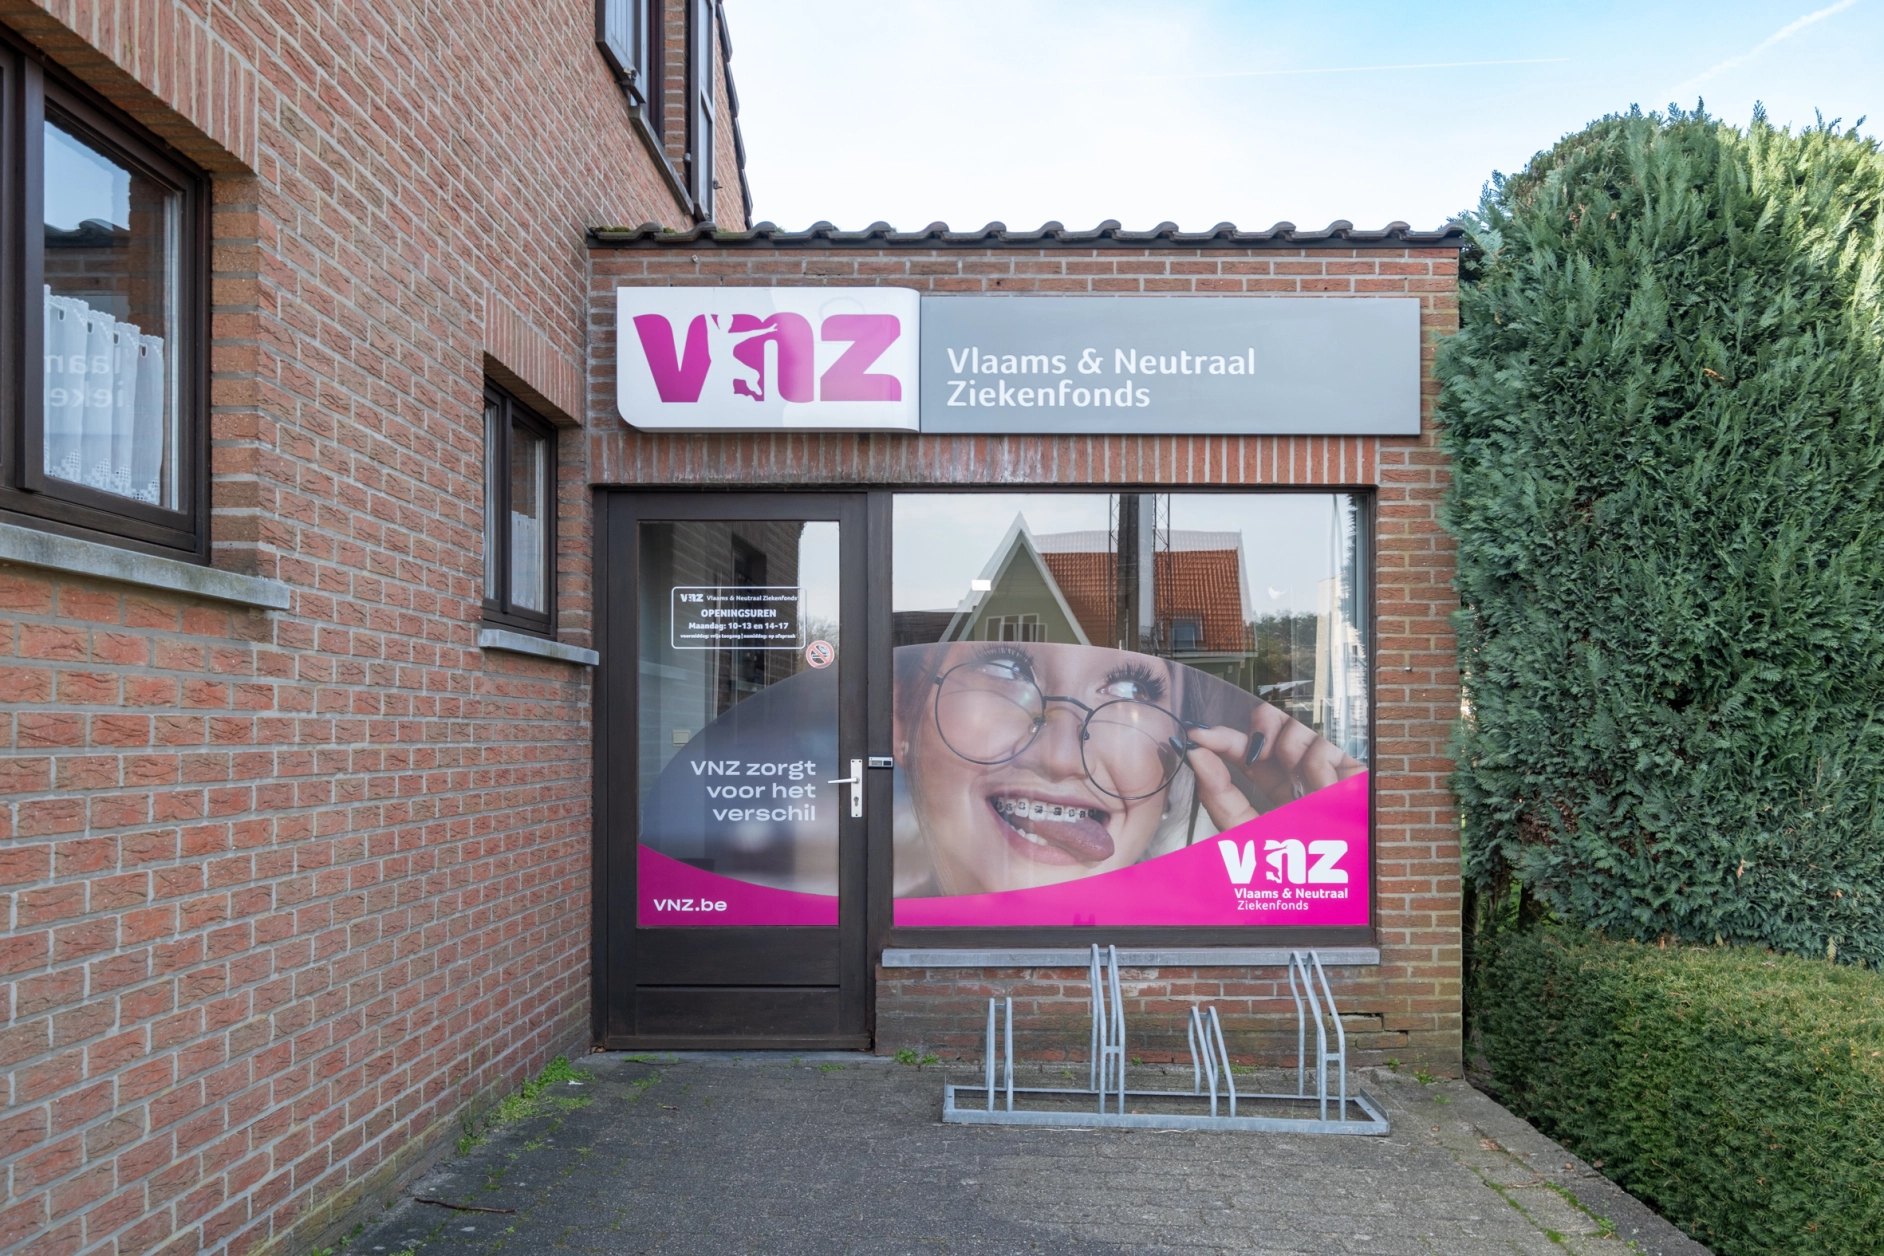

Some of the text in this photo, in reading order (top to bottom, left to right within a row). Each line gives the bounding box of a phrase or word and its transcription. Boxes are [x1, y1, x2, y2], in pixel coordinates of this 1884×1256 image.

[947, 346, 1255, 375] Vlaams & Neutraal
[946, 379, 1151, 407] Ziekenfonds
[701, 609, 777, 618] OPENINGSUREN
[688, 622, 727, 631] Maandag:
[728, 622, 752, 630] 10-13
[765, 622, 789, 630] 14-17
[690, 760, 816, 781] VNZ zorgt
[706, 783, 816, 799] voor het
[712, 804, 816, 822] verschil
[1234, 887, 1348, 899] Vlaams & Neutraal
[653, 898, 728, 912] VNZ.be
[1237, 900, 1309, 911] Ziekenfonds
